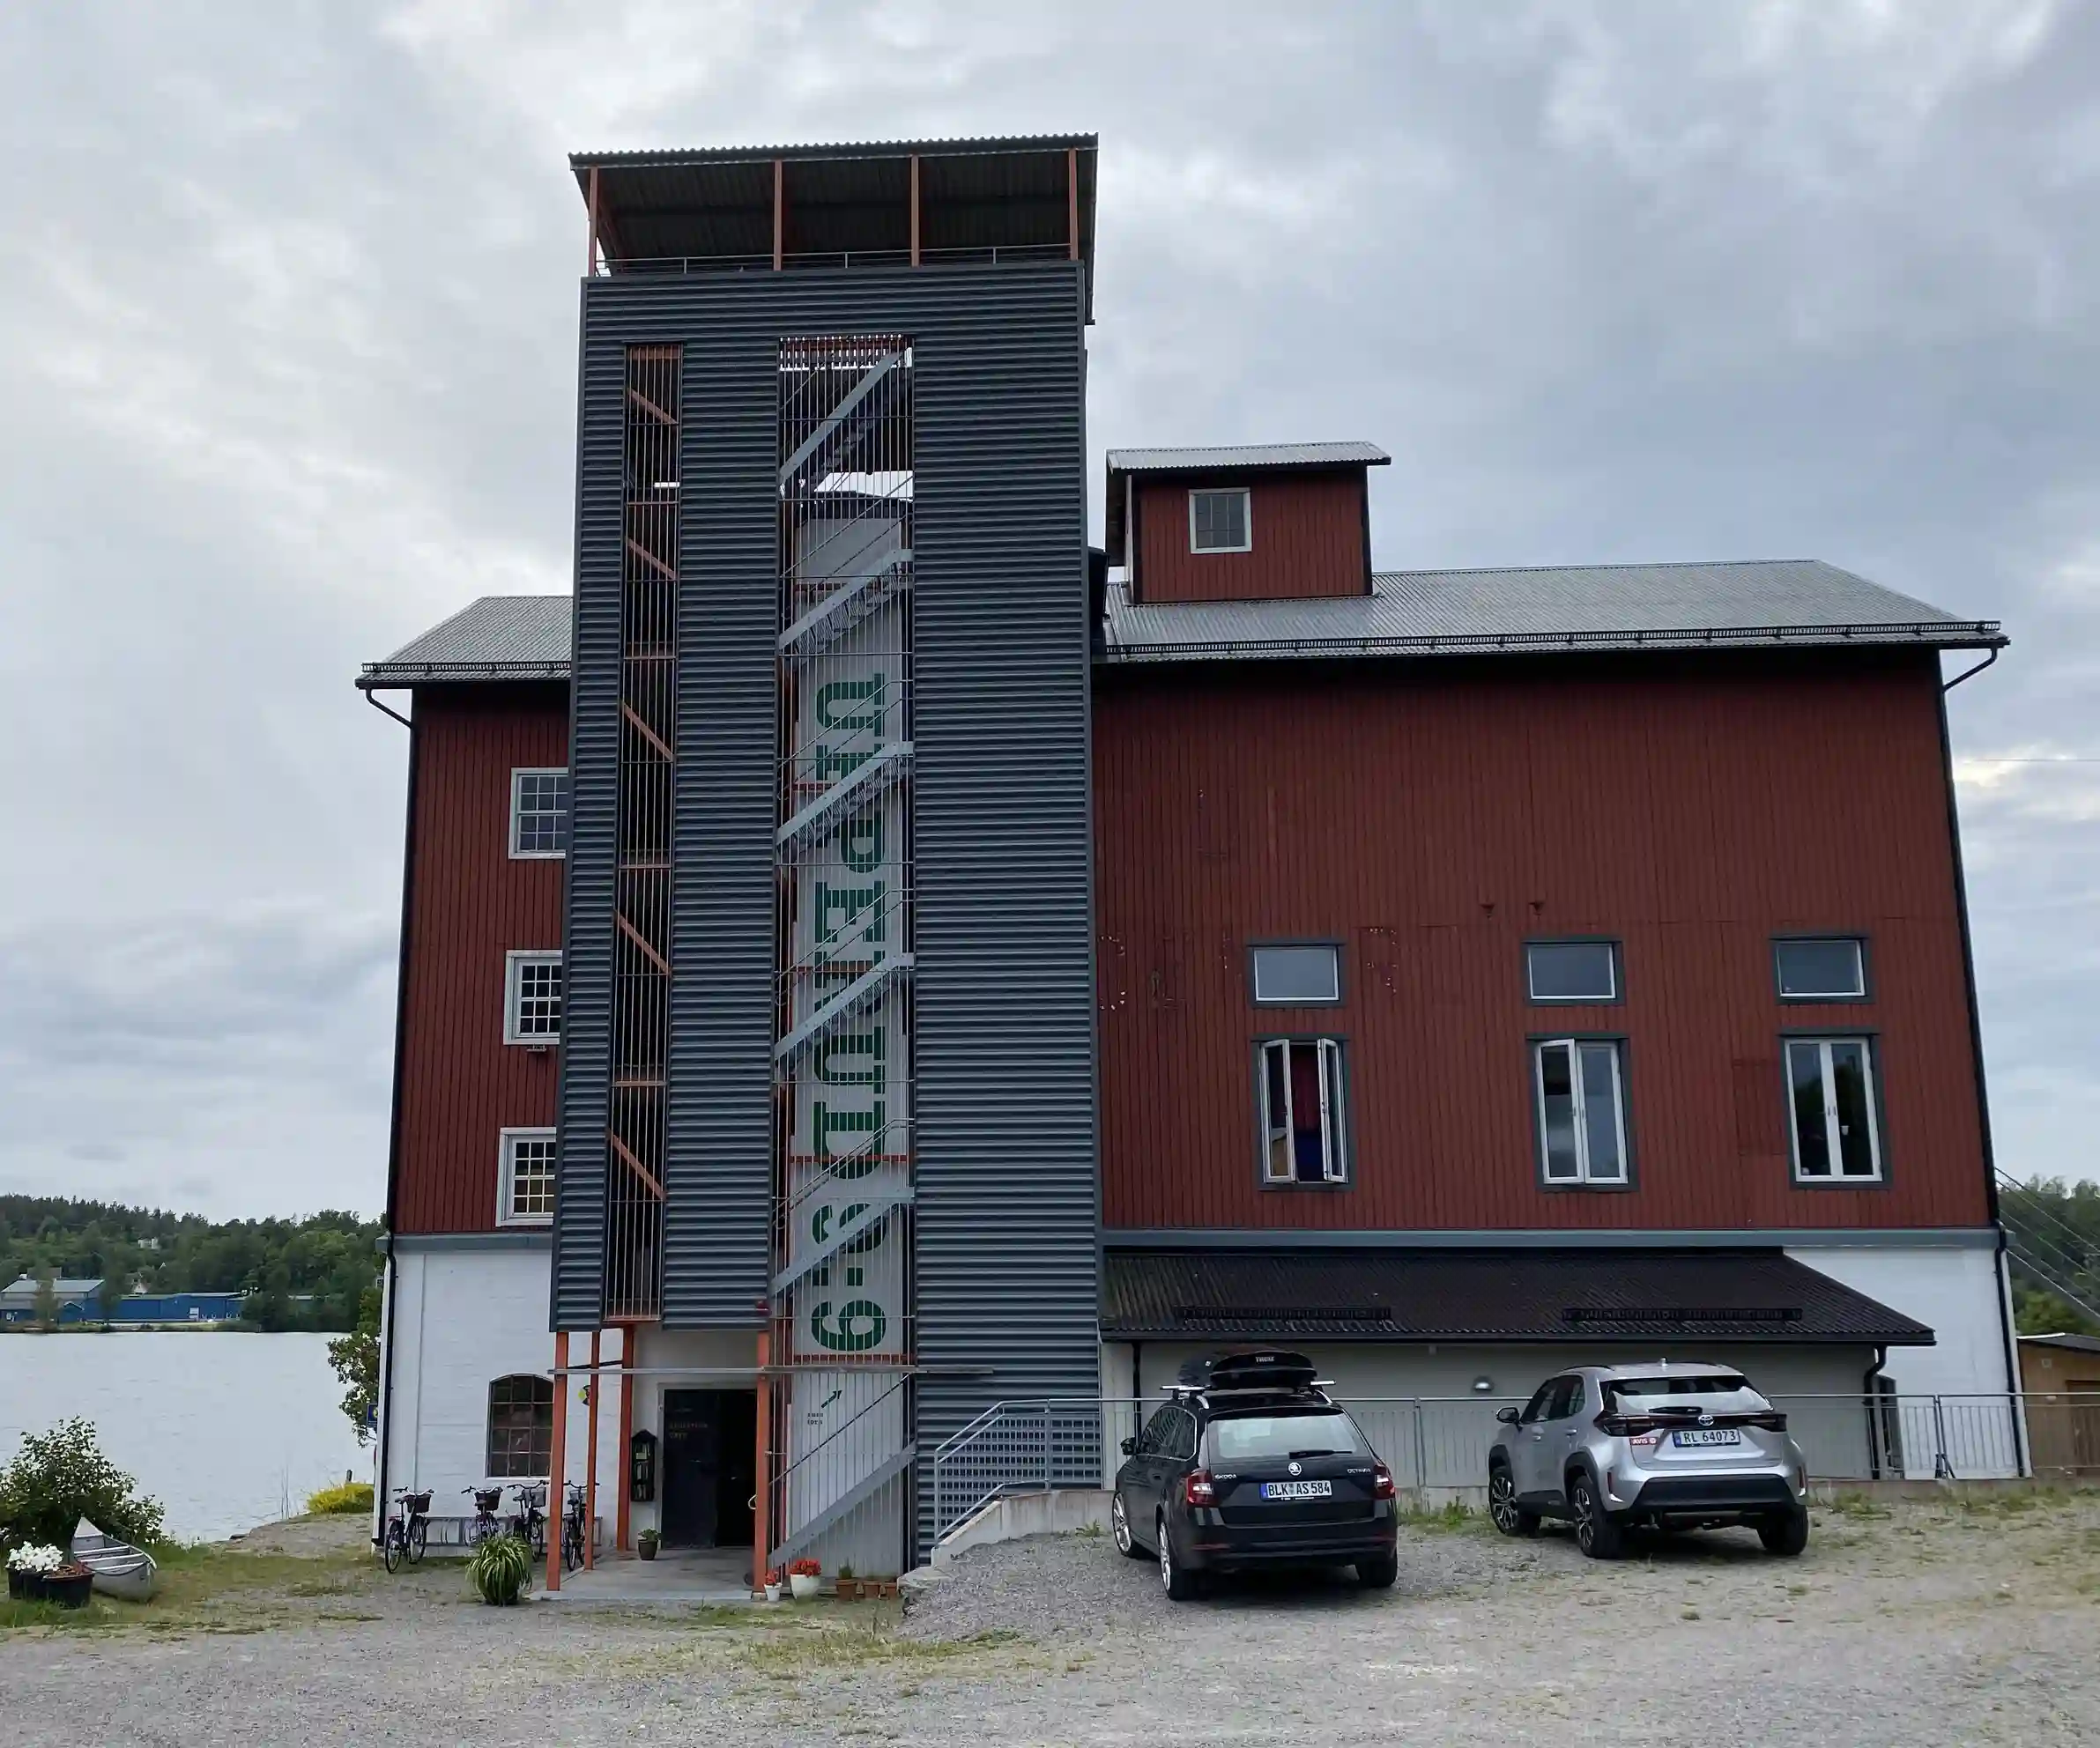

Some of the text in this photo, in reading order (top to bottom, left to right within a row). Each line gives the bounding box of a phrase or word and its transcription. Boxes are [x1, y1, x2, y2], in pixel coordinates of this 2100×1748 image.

[1684, 1431, 1736, 1442] RL 64073
[1268, 1481, 1331, 1496] BLK AS 584
